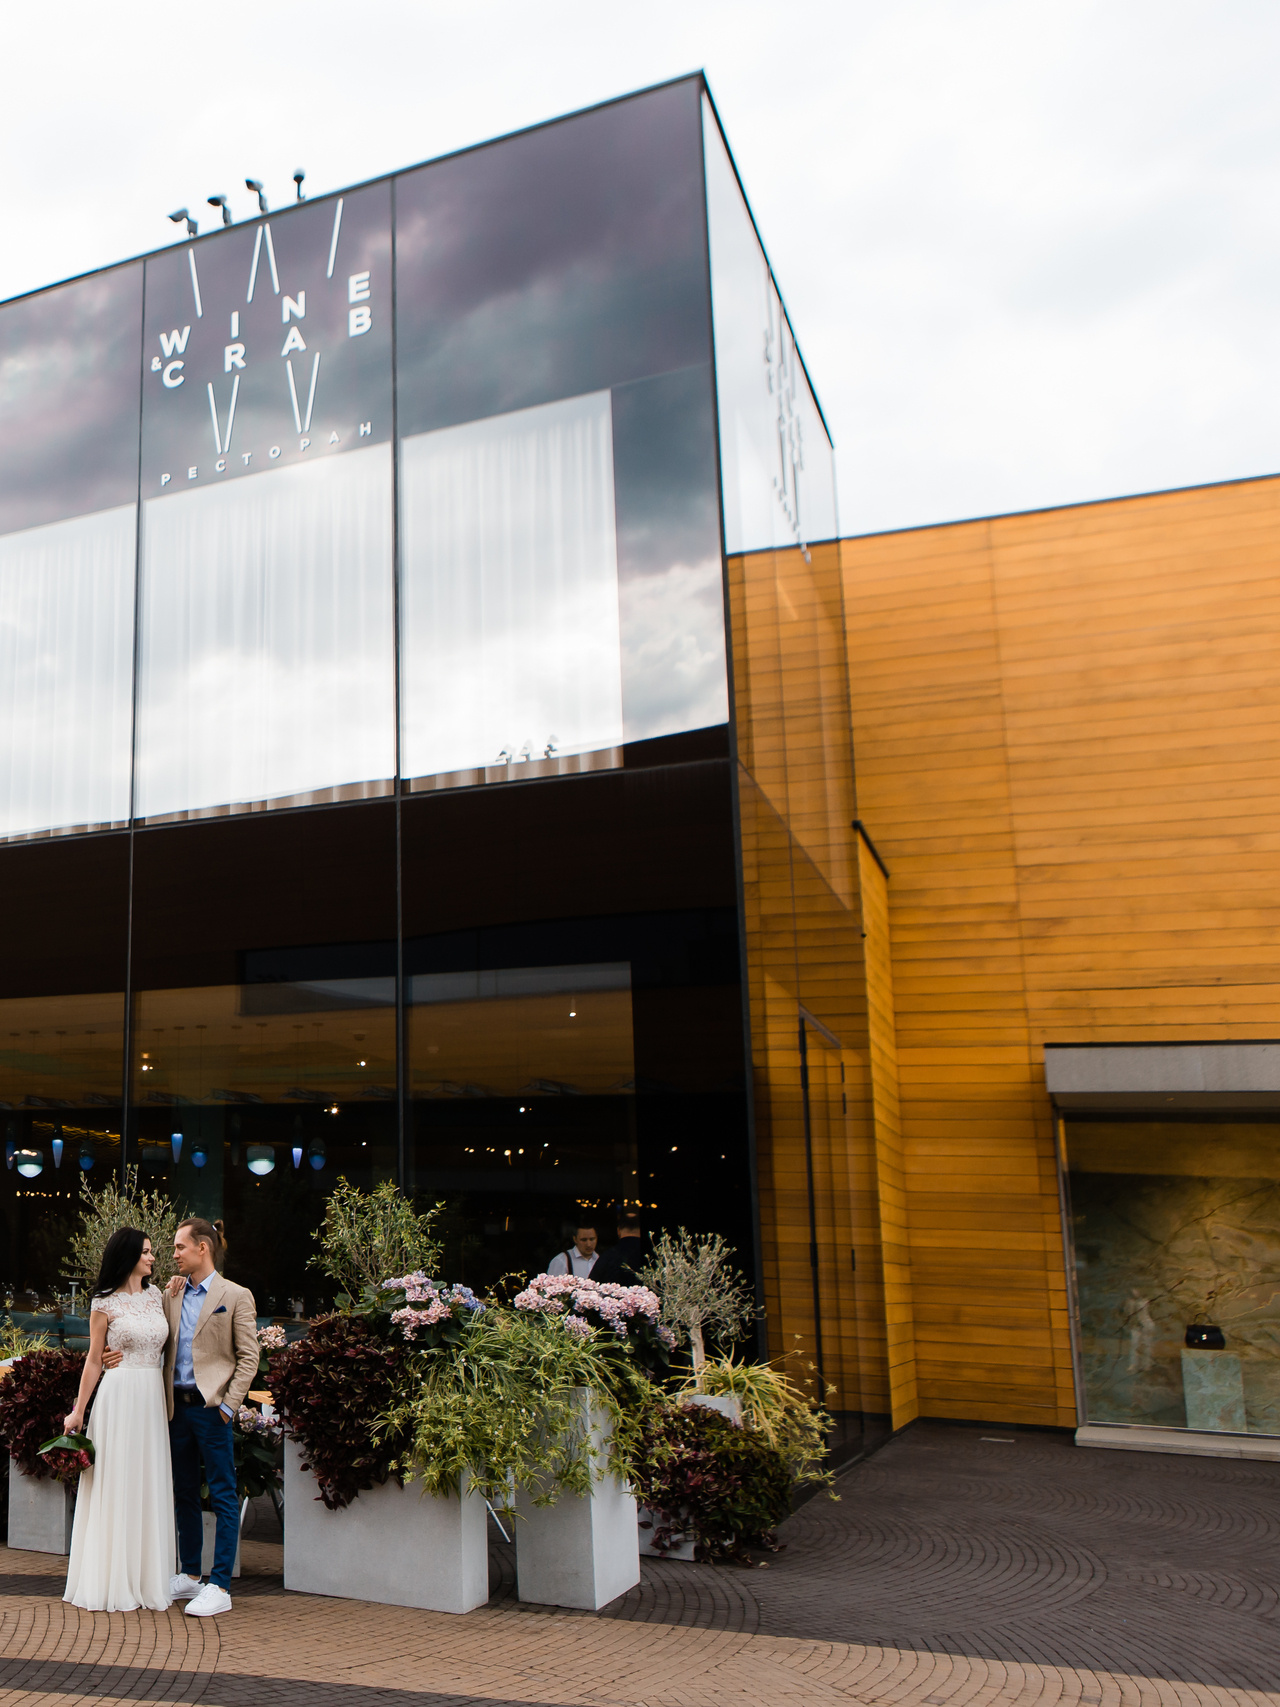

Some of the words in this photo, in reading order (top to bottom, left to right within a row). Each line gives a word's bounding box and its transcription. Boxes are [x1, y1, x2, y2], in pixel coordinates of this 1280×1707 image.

[159, 271, 371, 358] WINE
[162, 305, 372, 388] CRAB
[160, 421, 372, 486] РЕСТОРАН
